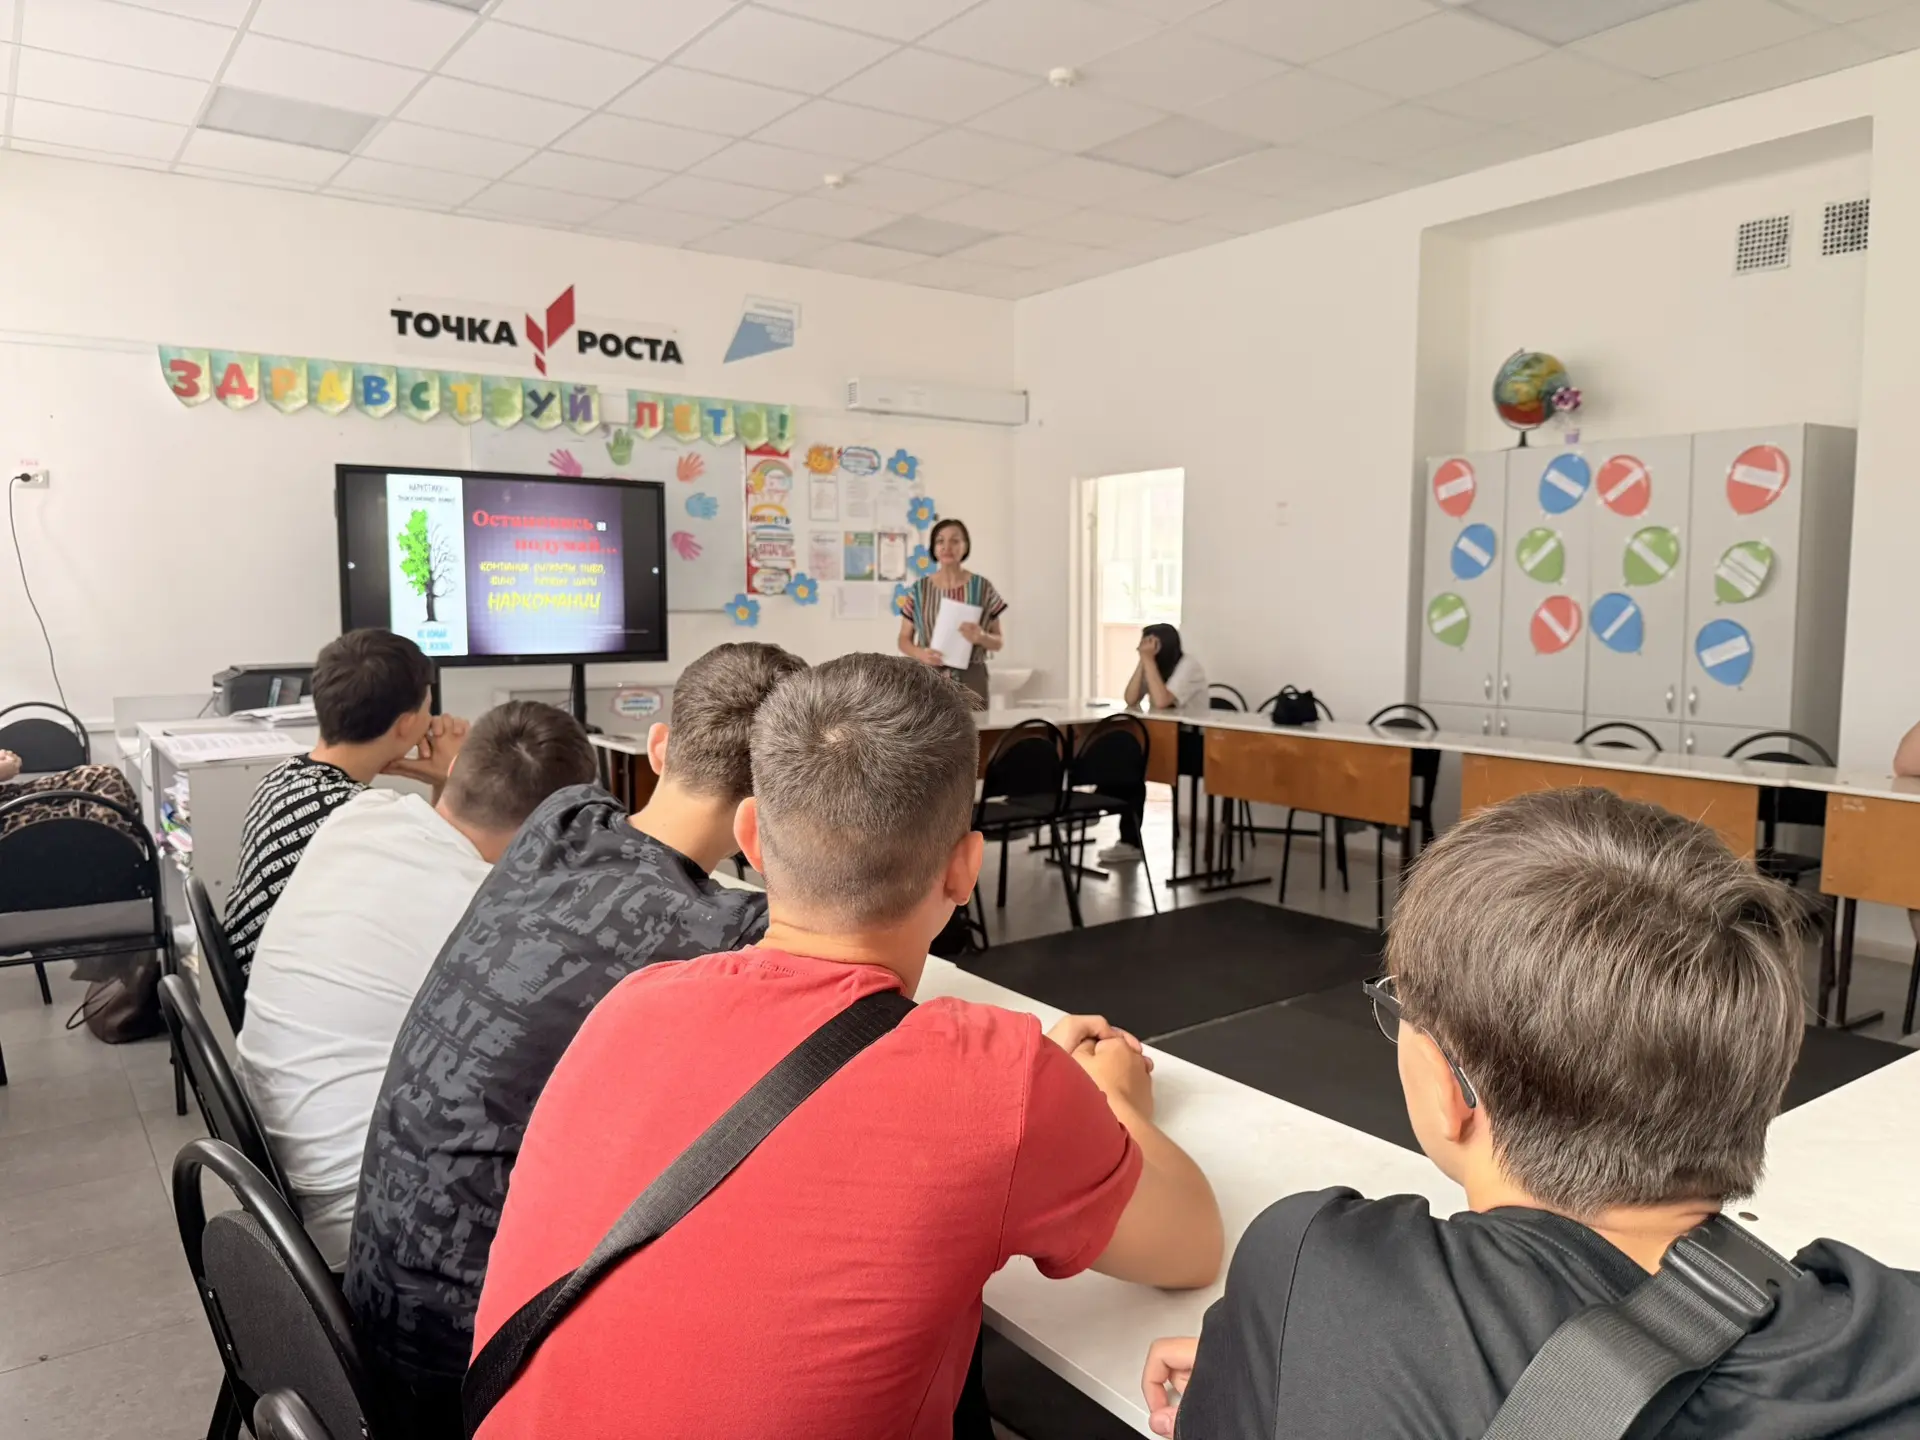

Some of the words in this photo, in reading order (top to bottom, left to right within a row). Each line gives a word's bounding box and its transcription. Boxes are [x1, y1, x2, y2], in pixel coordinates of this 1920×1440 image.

[390, 309, 518, 347] ТОЧКА
[577, 329, 684, 364] РОСТА
[169, 359, 593, 423] ЗДРАВСТВУЙ
[488, 591, 602, 612] НАРКОМАНИИ
[286, 785, 318, 805] RULES
[269, 813, 295, 833] YOUR
[292, 801, 320, 820] MIND
[258, 839, 282, 863] BREAK
[279, 829, 301, 847] THE
[260, 858, 285, 878] OPEN
